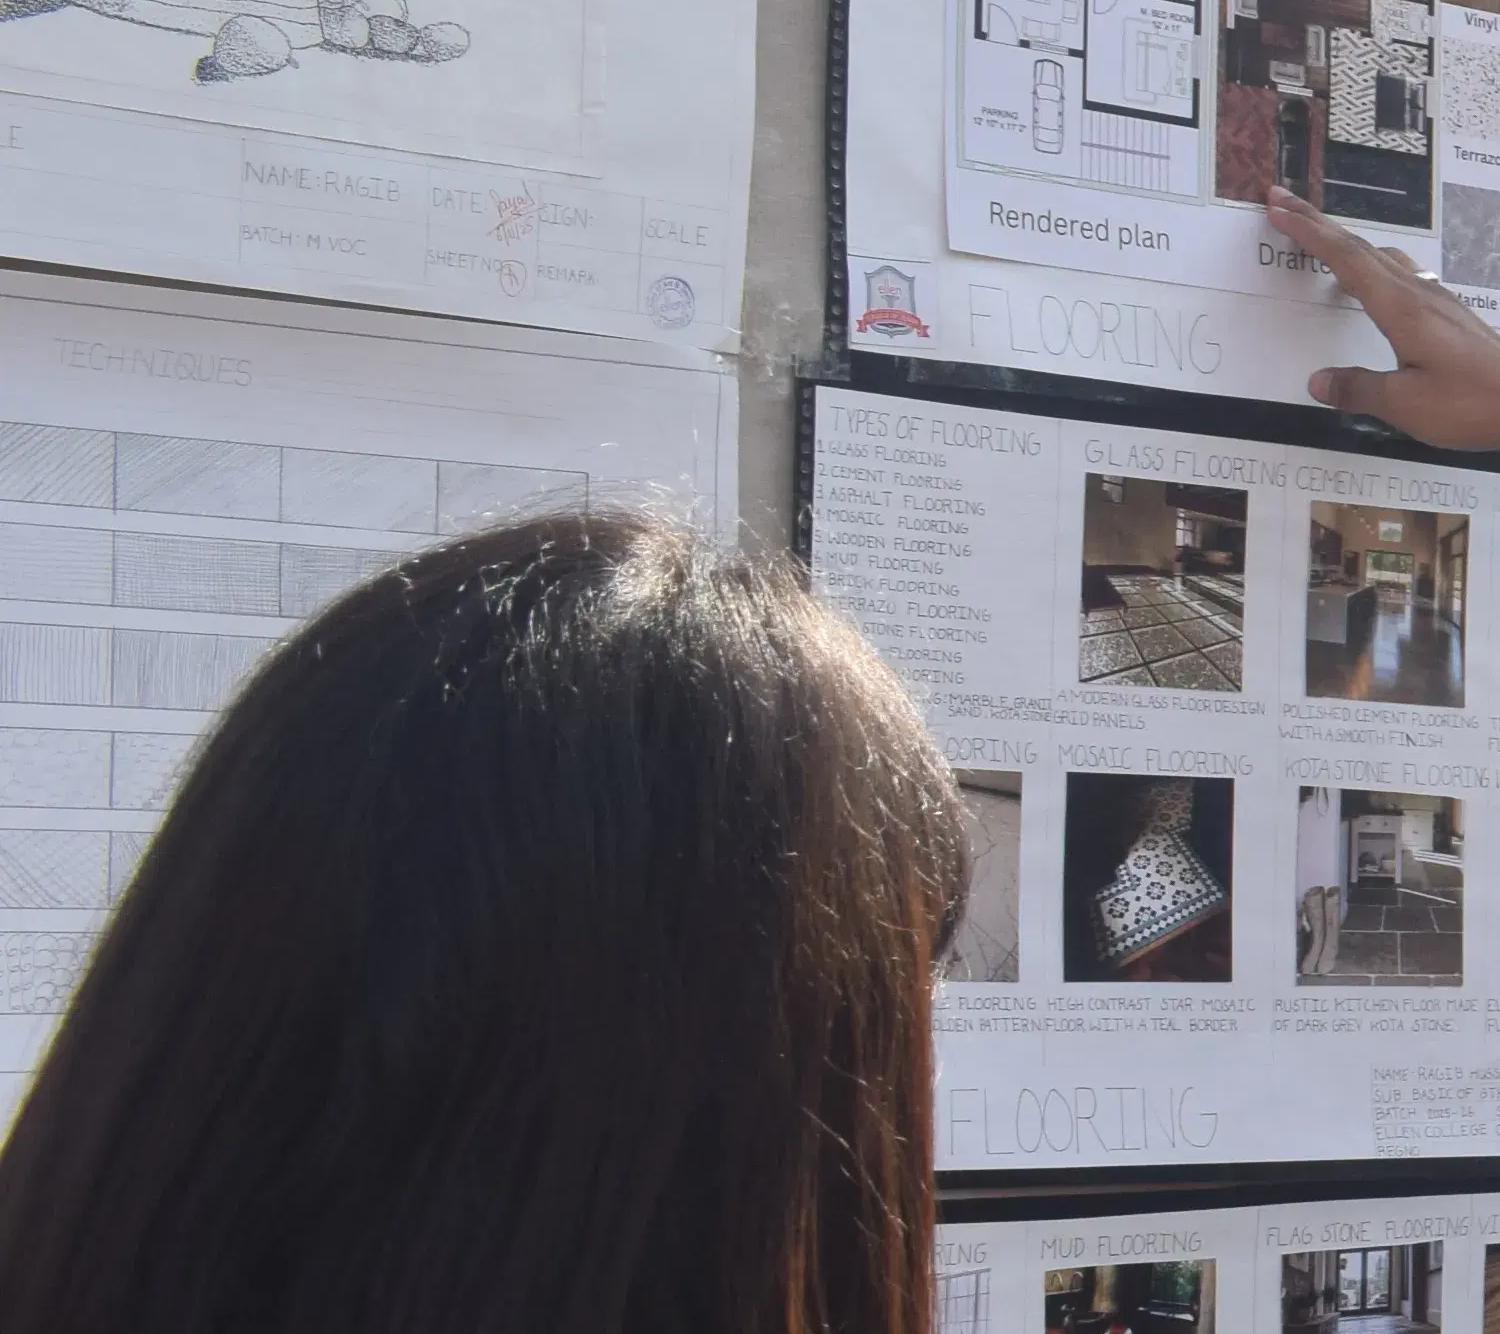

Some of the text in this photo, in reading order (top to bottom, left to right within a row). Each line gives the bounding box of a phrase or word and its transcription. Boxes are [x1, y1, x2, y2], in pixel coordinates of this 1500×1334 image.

[1465, 12, 1498, 33] Vinyl
[982, 107, 1018, 120] PARKING
[645, 220, 708, 246] SCALE
[990, 202, 1170, 251] Rendered plan
[969, 284, 1222, 374] FLOORING
[54, 337, 252, 387] TECHNIQUES
[831, 406, 1041, 456] TYPES OF FLOORING
[828, 441, 946, 467] GLASS FLOORING
[1084, 439, 1287, 487] GLASS FLOORING
[831, 467, 963, 490] CEMENT FLOORING
[1297, 467, 1477, 509] CEMENT FLOORING
[830, 487, 985, 515] ASPHALT FLOORING
[828, 509, 969, 534] MOSAIC FLOORING
[828, 533, 972, 557] WOODEN FLOORING
[869, 556, 943, 575] FLOORING
[880, 579, 959, 596] FLOORING
[908, 602, 991, 621] FLOORING
[1067, 690, 1130, 708] MODERN
[1282, 704, 1479, 729] POLISHED CEMENT FLOORING
[1059, 745, 1253, 775] MOSAIC FLOORING
[1405, 764, 1489, 789] FLOORING
[1049, 999, 1255, 1012] HIGH CONTRAST STAR MOSAIC
[1275, 998, 1441, 1013] RUSTIC KITCHEN FLOOR
[1152, 1019, 1238, 1032] TEAL BORDER
[1296, 1019, 1404, 1032] DARK GREY KOTA
[950, 1087, 1218, 1154] FLOORING
[1268, 1217, 1469, 1246] FLAG STONE FLOORING
[1042, 1232, 1201, 1259] MUD FLOORING
